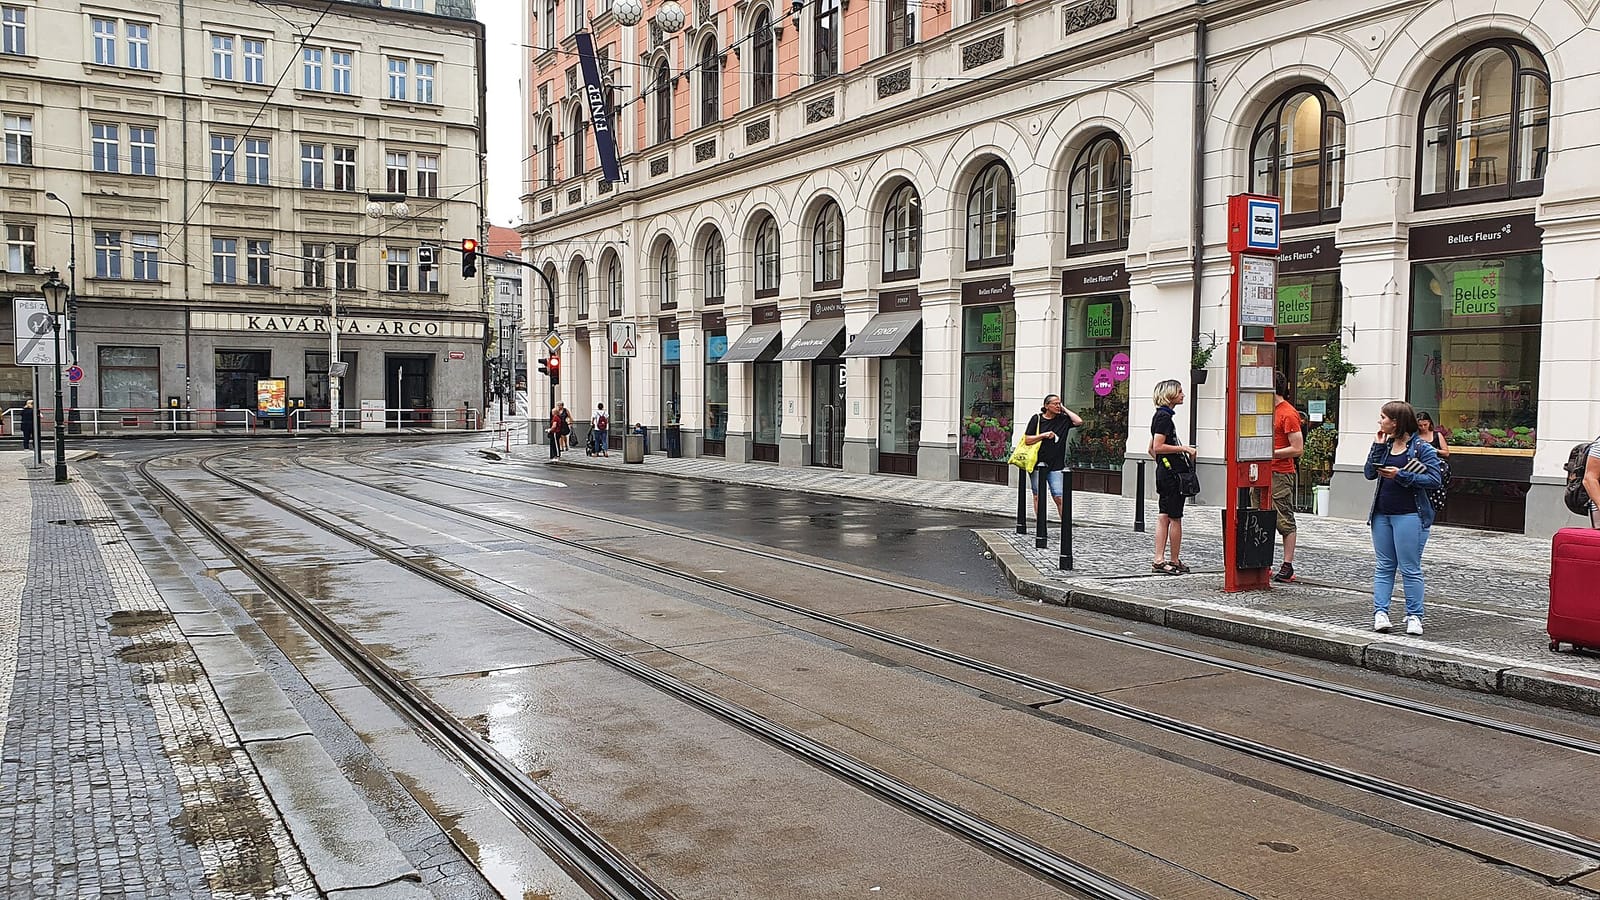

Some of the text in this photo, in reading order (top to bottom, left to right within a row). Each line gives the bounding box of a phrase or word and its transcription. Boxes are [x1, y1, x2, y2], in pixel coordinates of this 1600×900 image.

[588, 84, 608, 132] FINEP
[1448, 232, 1502, 244] Belles Fleurs
[1276, 252, 1313, 262] elles Fleurs
[1083, 274, 1113, 284] Belles Fleurs
[978, 287, 1003, 296] Belles Fleurs
[1455, 286, 1497, 300] Belles
[1279, 299, 1310, 312] Belles
[1454, 300, 1496, 314] Fleurs
[1088, 317, 1111, 327] Belles
[1278, 311, 1310, 324] Fleurs
[247, 315, 438, 336] KAVÁRNA ARCO
[983, 324, 1001, 334] Belles
[1088, 326, 1111, 337] Fleurs
[982, 333, 1001, 342] Fleurs
[883, 377, 893, 434] FINEP
